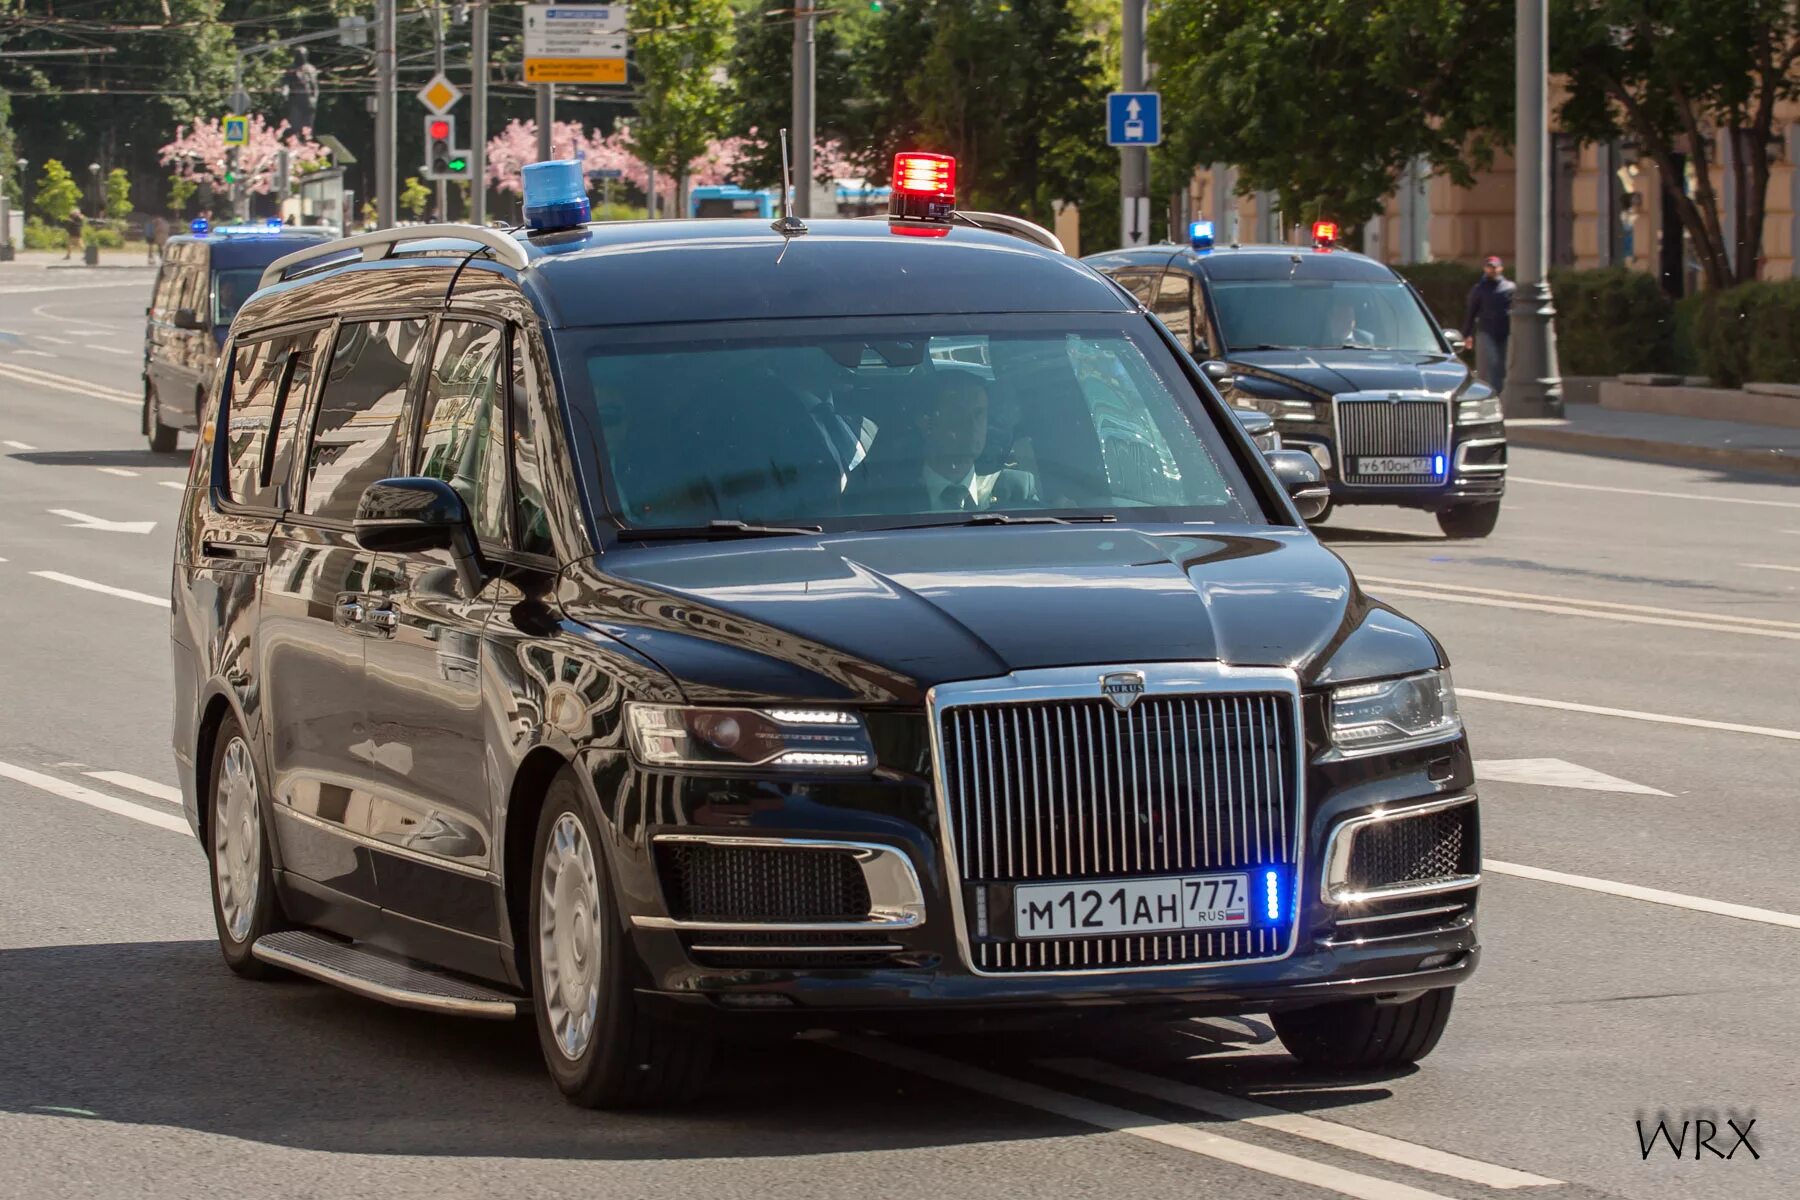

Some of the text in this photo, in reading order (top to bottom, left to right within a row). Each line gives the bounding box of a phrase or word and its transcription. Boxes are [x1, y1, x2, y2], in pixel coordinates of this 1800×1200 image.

[1104, 684, 1144, 693] AURUS
[1028, 879, 1238, 930] М121АН 777
[1198, 910, 1225, 921] RUS
